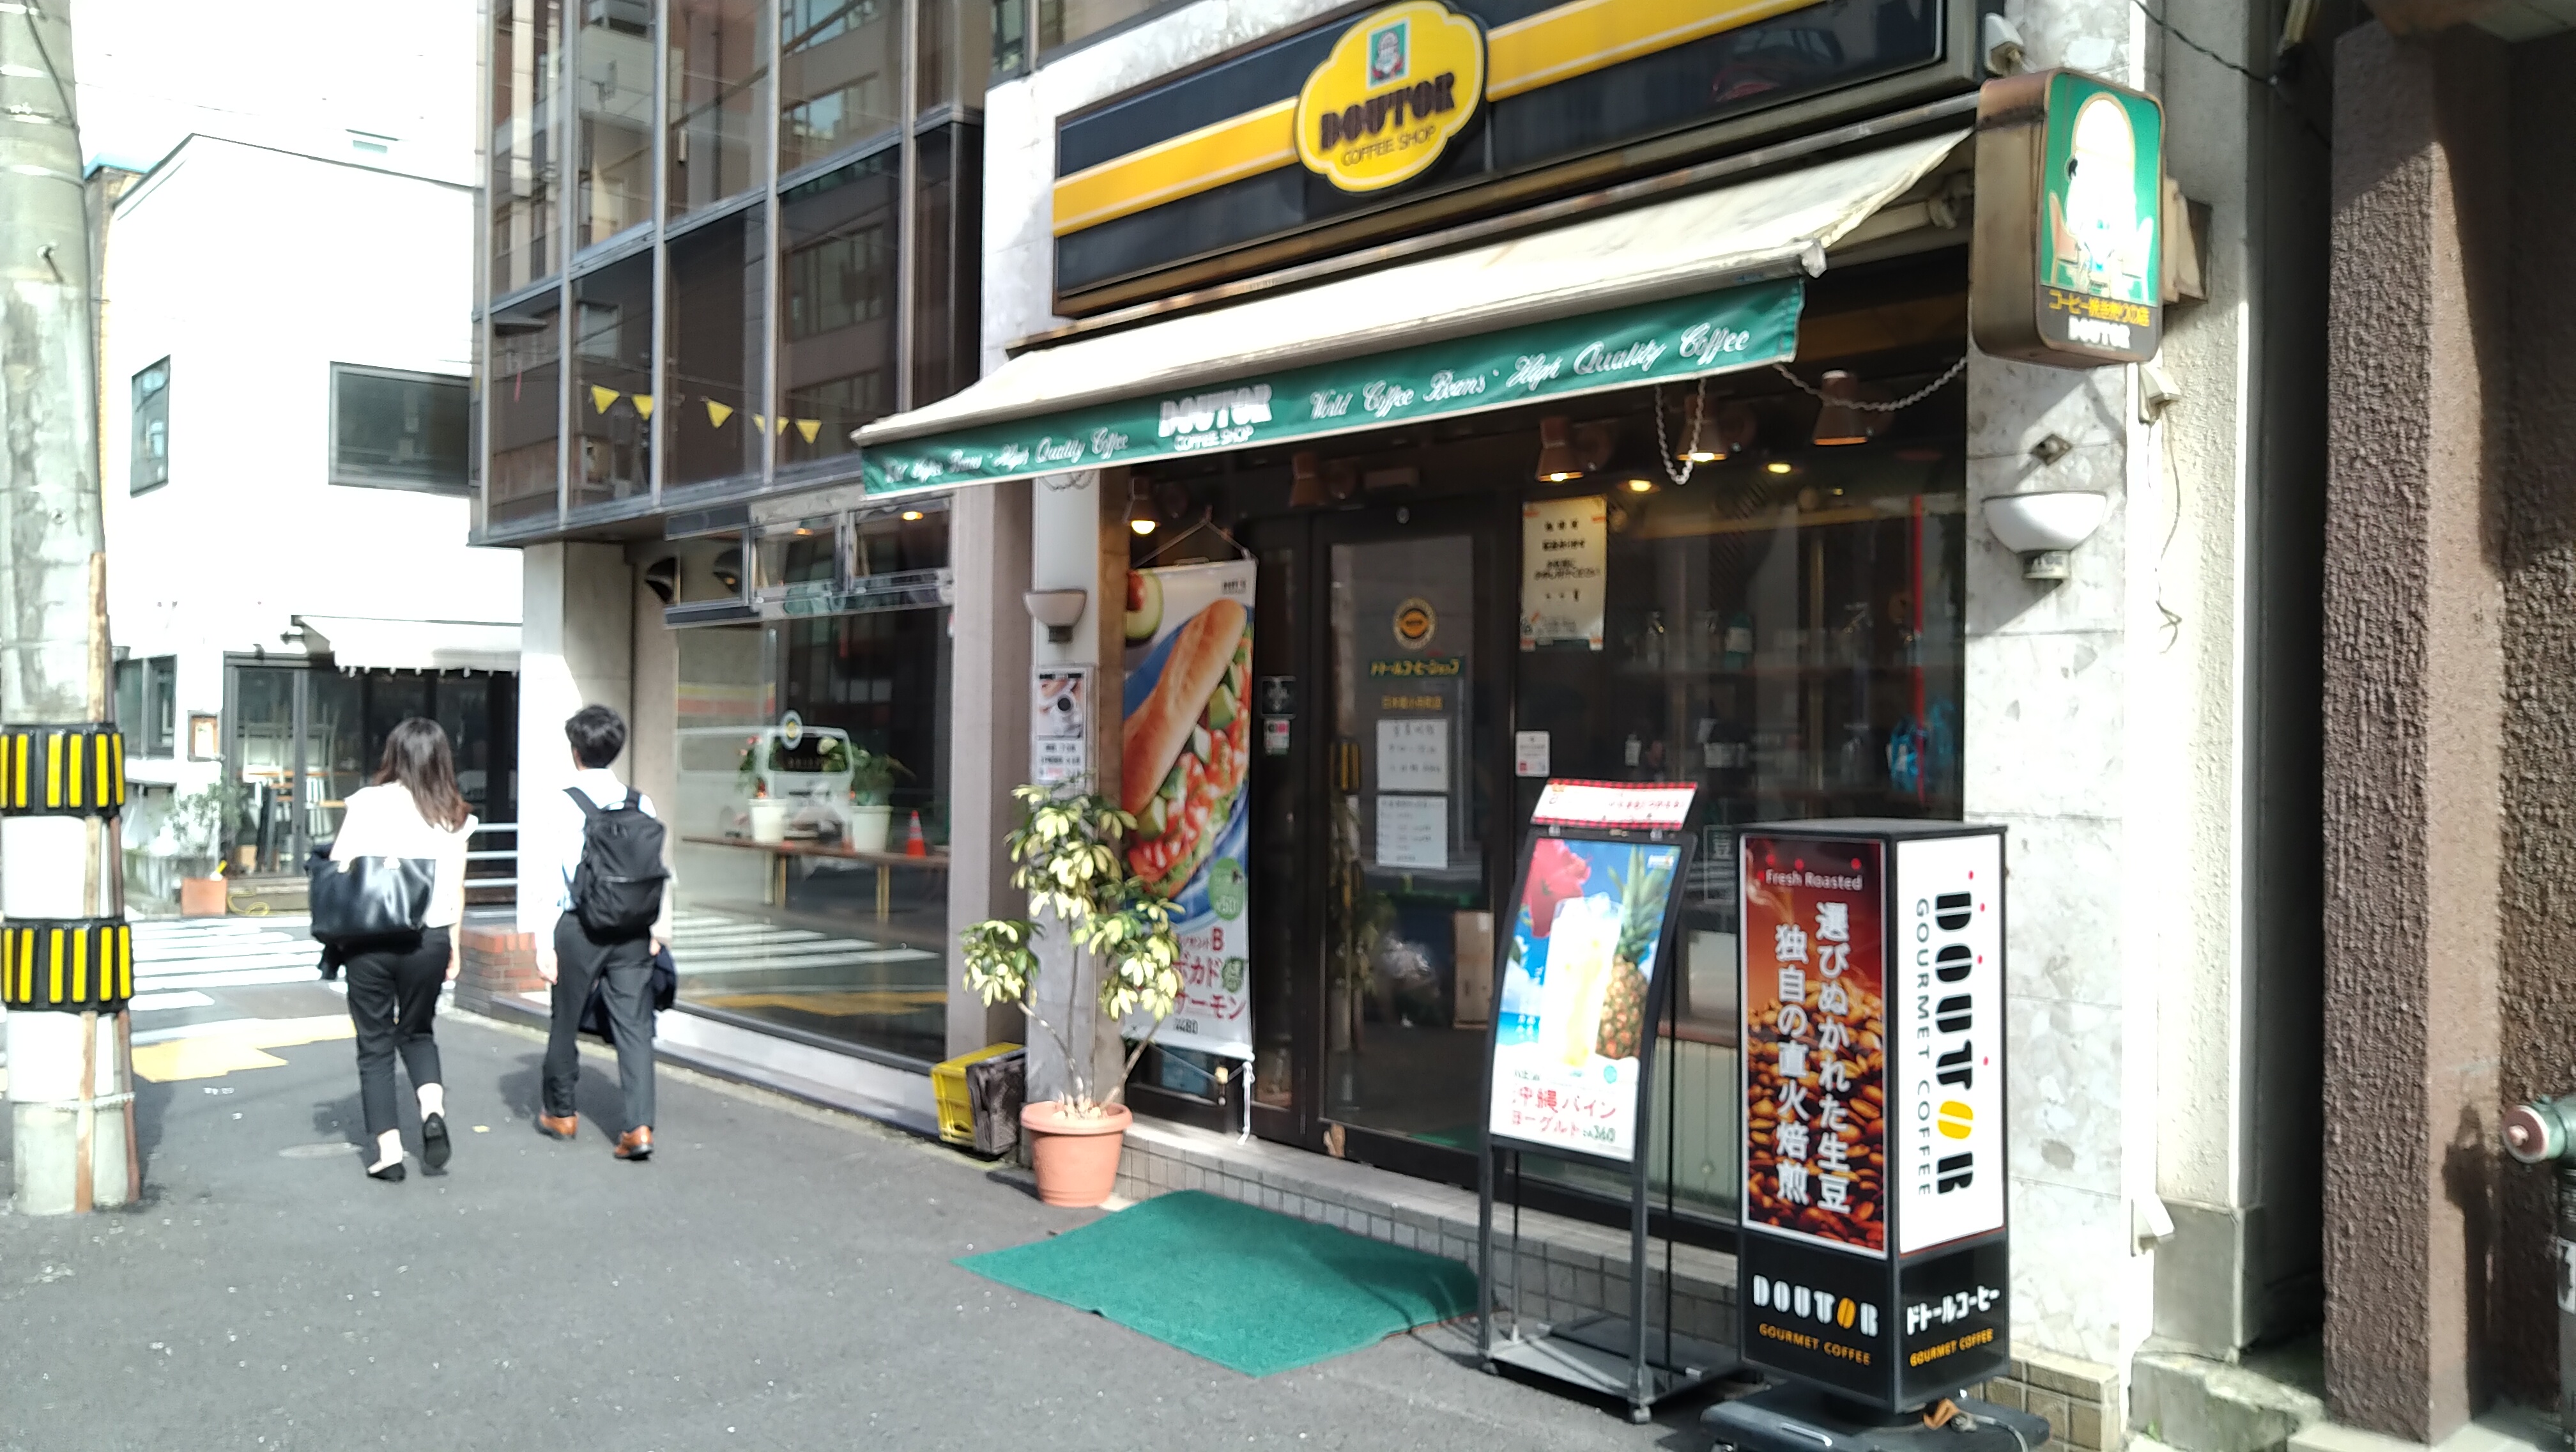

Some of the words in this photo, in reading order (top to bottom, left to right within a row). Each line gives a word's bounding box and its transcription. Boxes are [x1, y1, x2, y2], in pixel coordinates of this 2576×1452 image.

[1320, 72, 1455, 151] DOUTOR
[1341, 139, 1395, 167] COFFEE
[1399, 126, 1437, 151] SHOP
[1310, 390, 1352, 420] World
[1363, 380, 1413, 418] Coffee
[1422, 369, 1487, 401] Beans
[1506, 353, 1565, 392] High
[1573, 339, 1667, 376] Quality
[1679, 321, 1751, 365] Coffee
[1158, 383, 1273, 438] DOUTOR
[1034, 436, 1086, 465] Quality
[1091, 427, 1130, 460] Coffee
[1174, 430, 1218, 452] COFFEE
[1219, 425, 1254, 446] SHOP
[1765, 869, 1802, 887] Fresh
[1805, 871, 1863, 891] Roasted
[1211, 927, 1225, 952] B
[1916, 899, 1930, 1060] GOURMET
[1774, 923, 1810, 1205] 独自の直火焙煎
[1816, 901, 1851, 1214] 選びぬかれた生豆
[1935, 890, 1974, 1195] DOUTOR
[1917, 1079, 1931, 1196] COFFEE
[1752, 1274, 1878, 1337] DOUTOR
[1906, 1285, 2000, 1336] ドトールコーヒー
[1758, 1322, 1820, 1350] GOURMET
[1823, 1341, 1871, 1366] COFFEE
[1910, 1339, 1957, 1367] GOURMET
[1959, 1328, 1995, 1351] COFFEE
